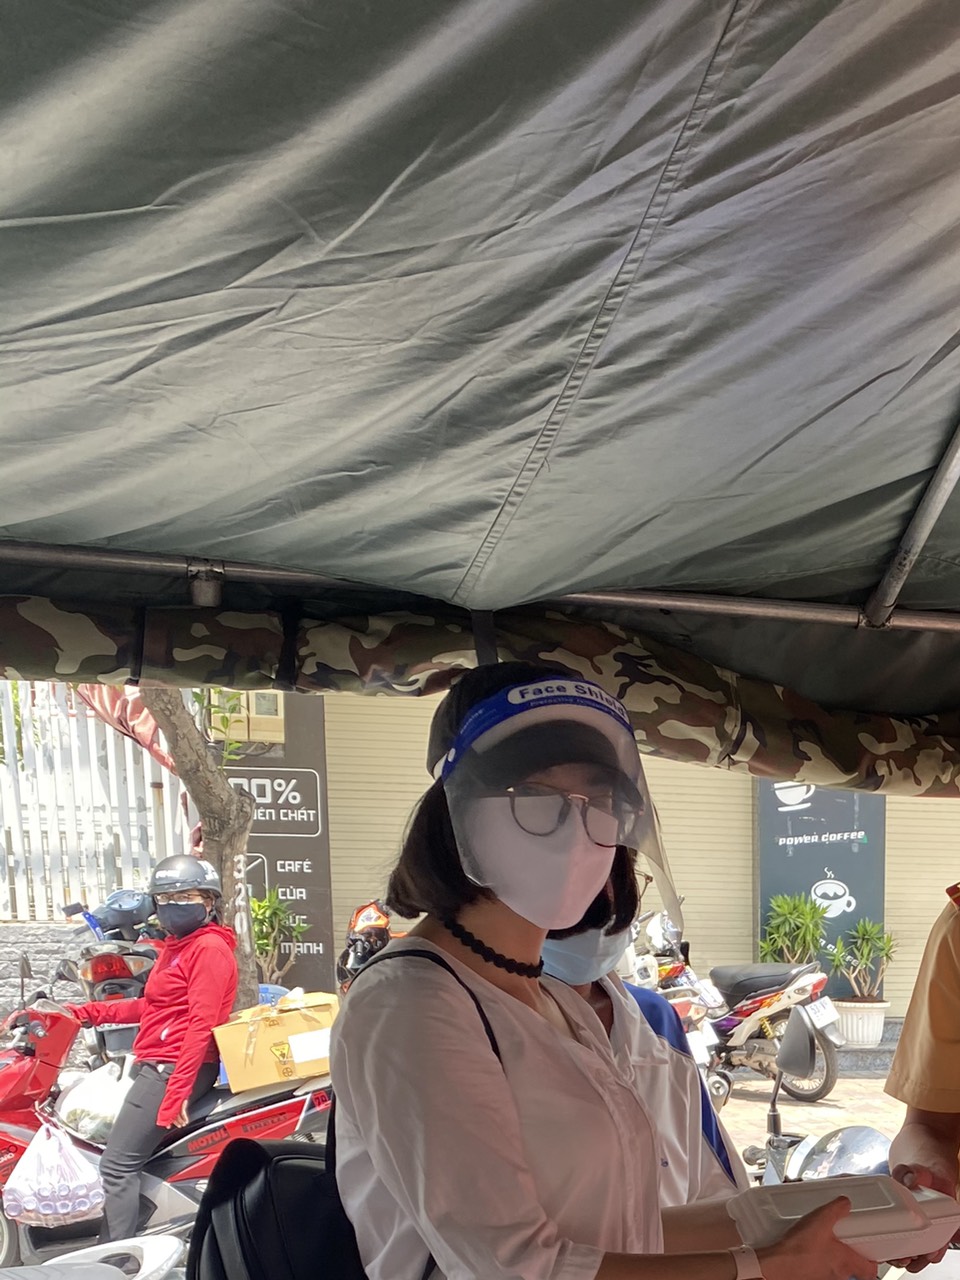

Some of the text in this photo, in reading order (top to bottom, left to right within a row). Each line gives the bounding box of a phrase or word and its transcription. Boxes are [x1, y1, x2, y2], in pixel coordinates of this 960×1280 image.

[519, 684, 567, 699] Face
[574, 684, 627, 718] Shield
[778, 830, 865, 846] POWER COFFEE
[276, 858, 312, 873] CAFÉ
[278, 885, 307, 900] CỦA
[188, 1128, 229, 1152] MOTUL
